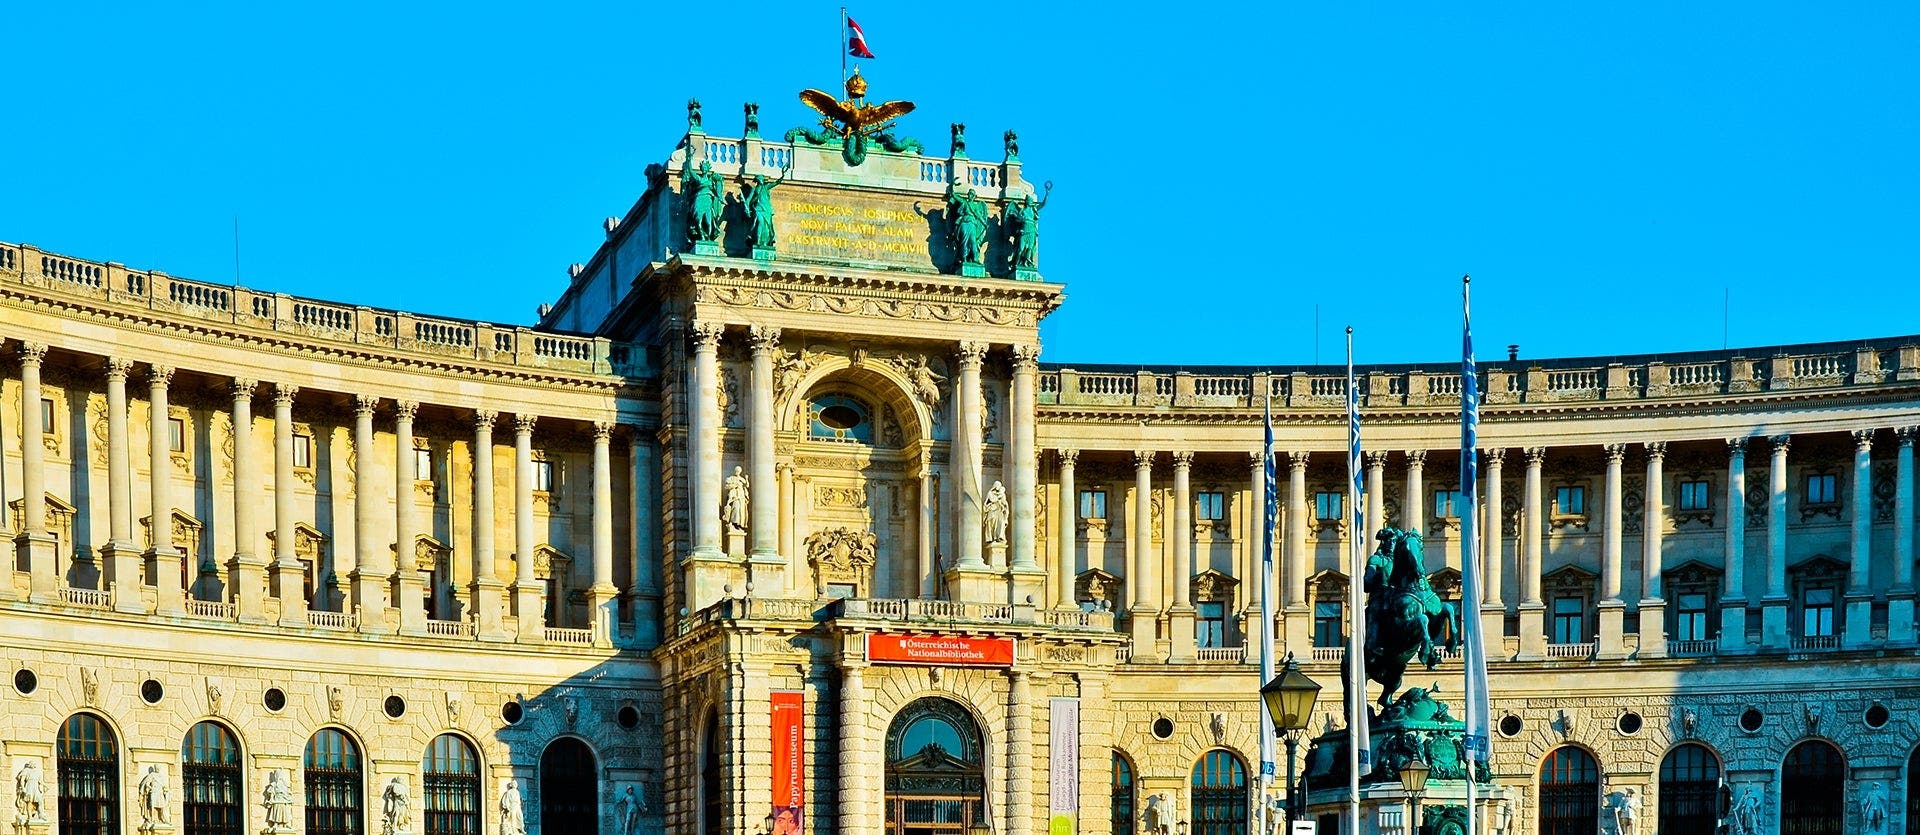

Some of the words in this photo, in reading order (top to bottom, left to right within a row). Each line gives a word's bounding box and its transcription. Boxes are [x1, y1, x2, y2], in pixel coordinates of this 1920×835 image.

[788, 202, 854, 216] FRANCISCVS
[864, 208, 914, 222] IOSEPHVS
[800, 219, 828, 230] NOVI
[835, 221, 875, 235] PALATII
[882, 226, 914, 238] ALAM
[907, 638, 970, 650] Österreichische
[908, 648, 985, 659] Nationalbibliothek
[789, 725, 800, 809] Papyrusmuseum
